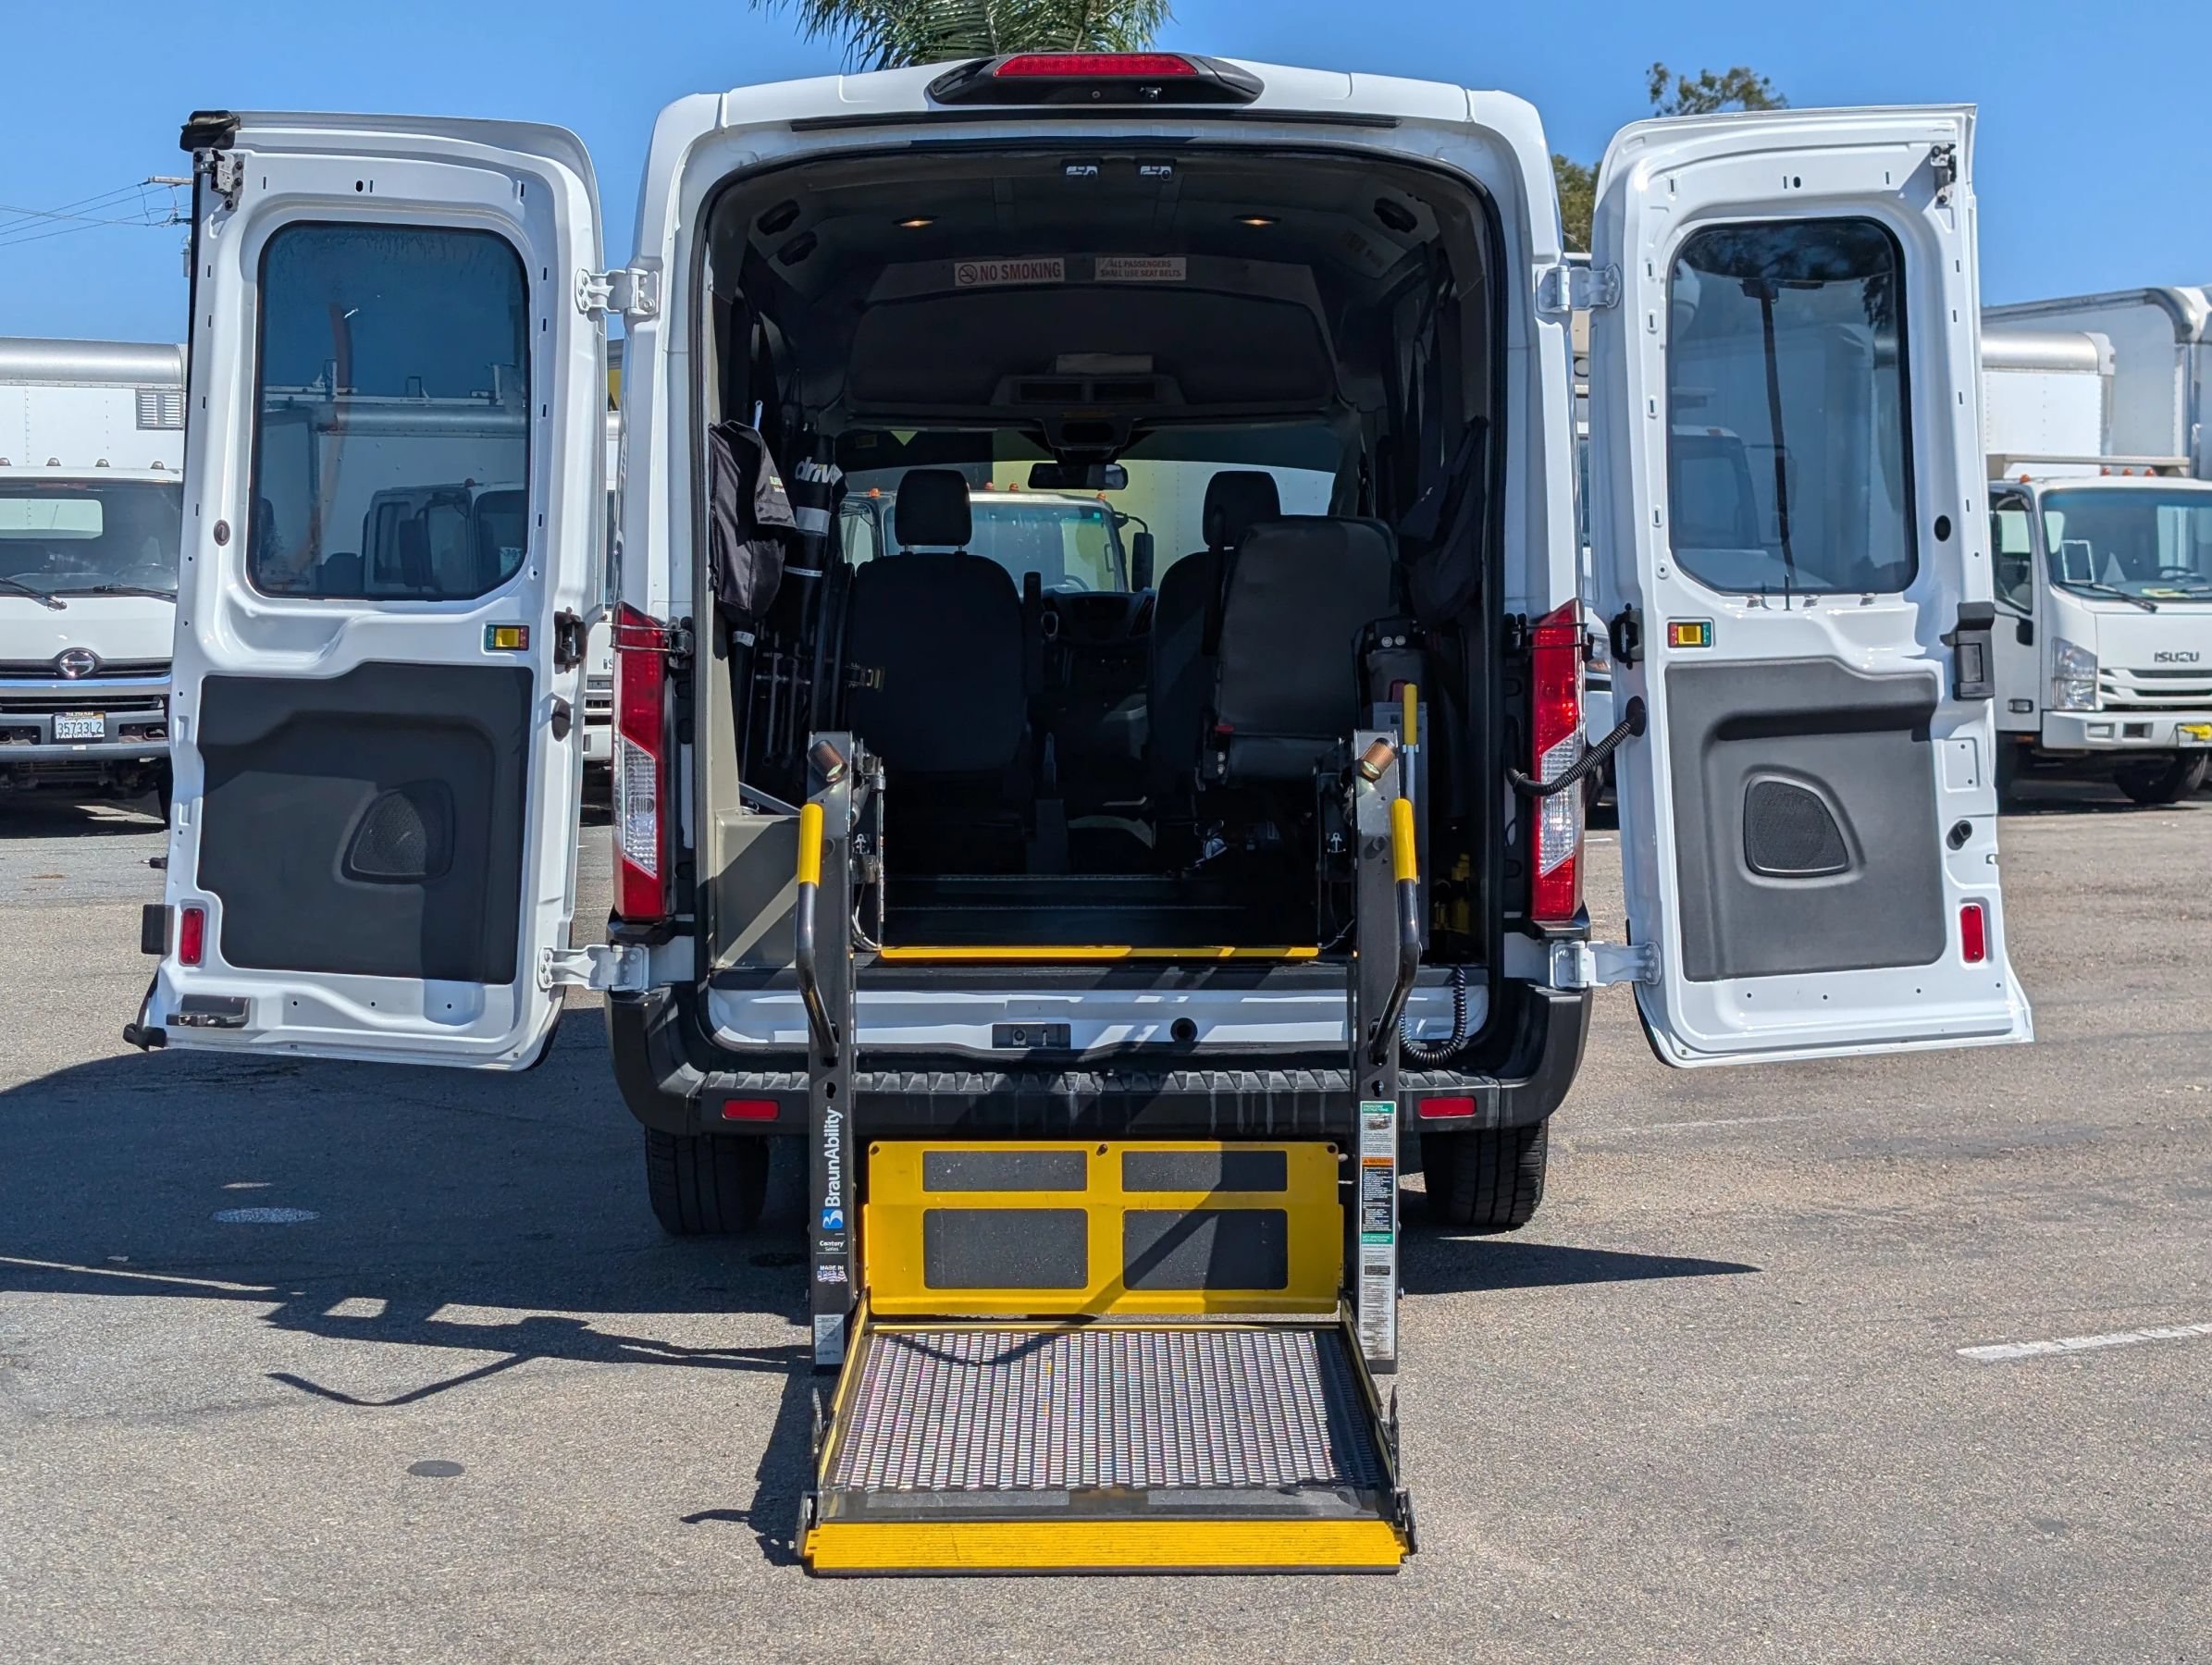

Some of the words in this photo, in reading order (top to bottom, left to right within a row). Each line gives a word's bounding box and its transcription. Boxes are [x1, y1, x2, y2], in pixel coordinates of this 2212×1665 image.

[1124, 260, 1171, 268] PASSENGERS
[981, 265, 998, 280] NO
[1001, 262, 1061, 280] SMOKING
[1125, 269, 1140, 278] USE
[1140, 269, 1158, 278] SEAT
[1159, 268, 1181, 278] BELTS
[2155, 651, 2199, 662] ISUZU
[57, 722, 103, 734] 35733L2
[823, 1108, 844, 1207] BraunAbility
[817, 1270, 848, 1282] USA
